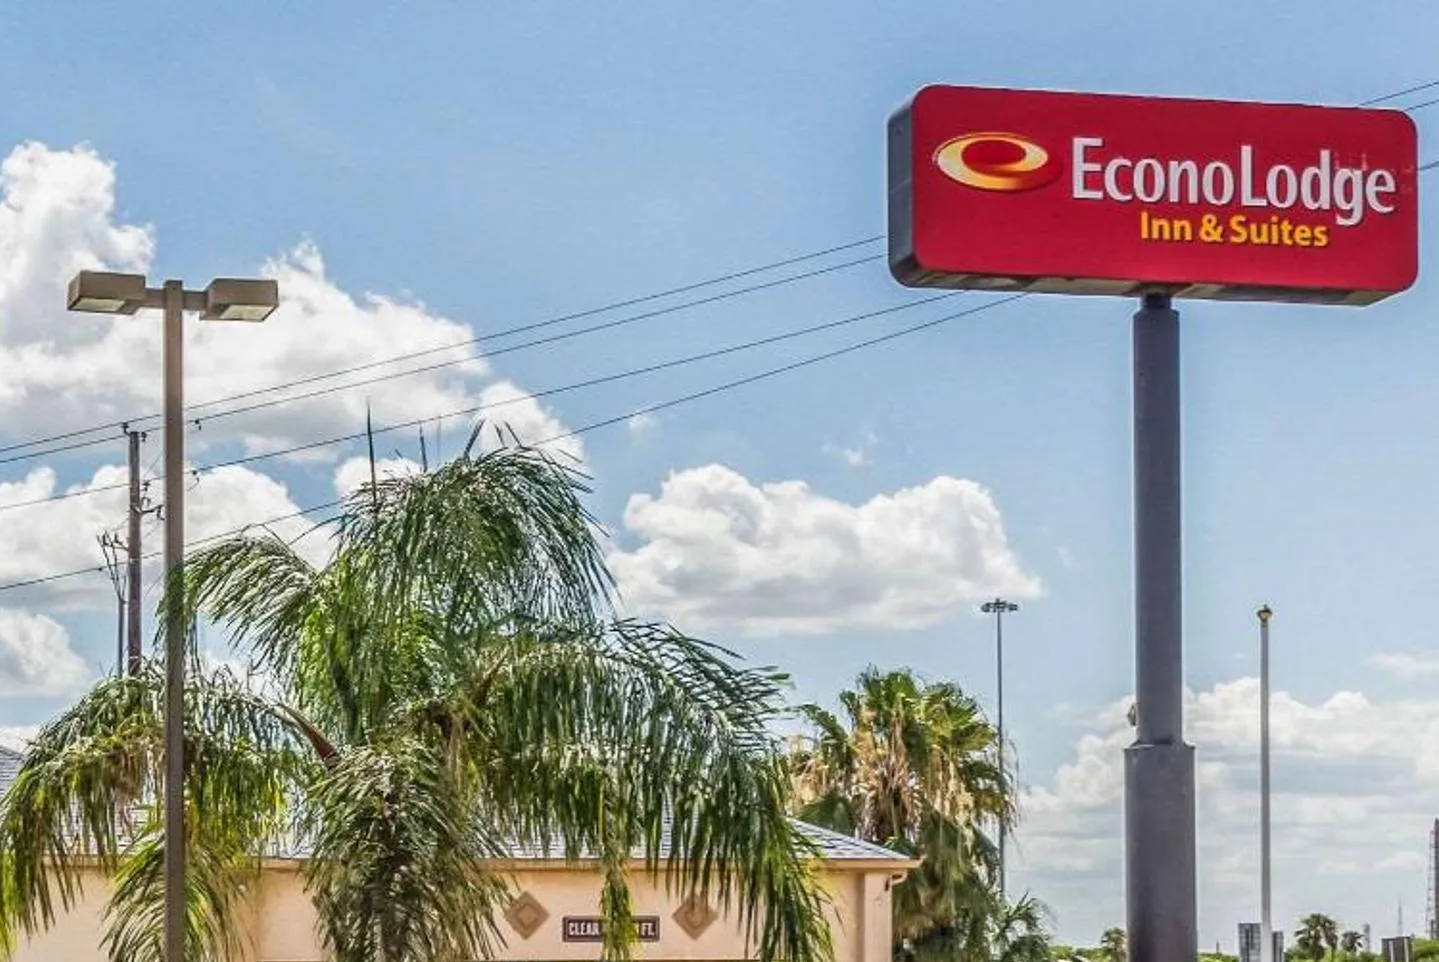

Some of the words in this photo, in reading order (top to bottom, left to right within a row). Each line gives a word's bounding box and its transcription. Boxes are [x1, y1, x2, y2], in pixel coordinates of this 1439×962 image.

[1140, 211, 1193, 243] Inn
[1199, 214, 1223, 244] &
[1230, 213, 1329, 248] Suites
